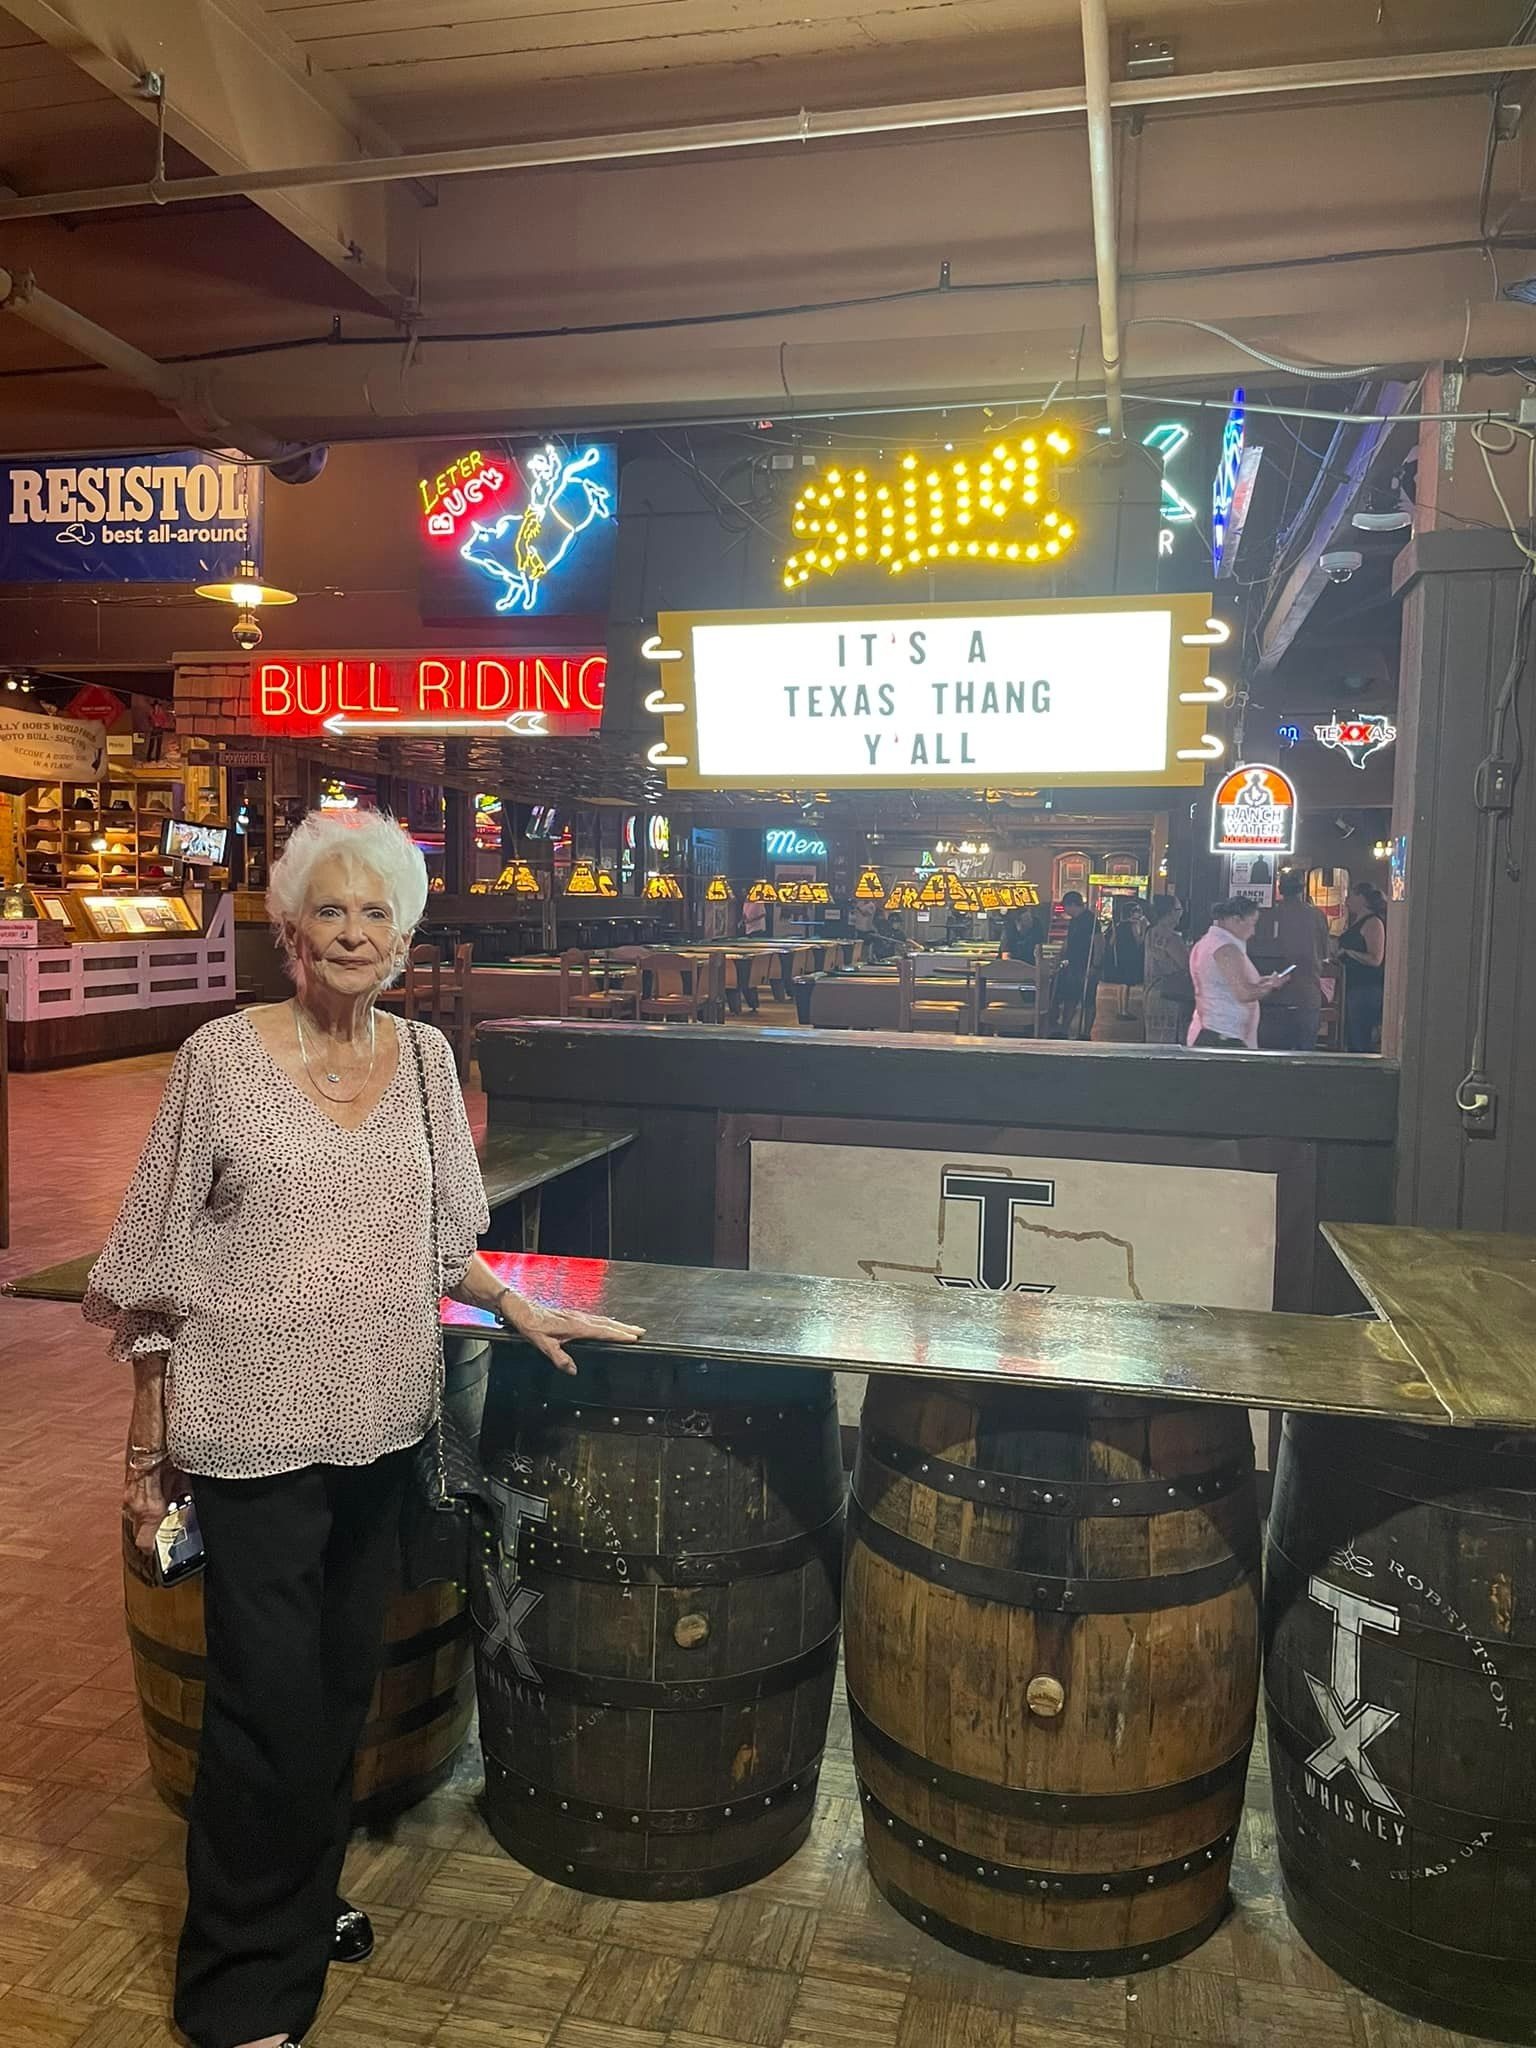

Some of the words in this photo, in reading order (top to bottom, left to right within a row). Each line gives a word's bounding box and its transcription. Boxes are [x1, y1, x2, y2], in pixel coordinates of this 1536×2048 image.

[9, 464, 248, 523] RESISTOL
[419, 450, 484, 515] LET'ER
[428, 467, 503, 535] BUCK
[783, 428, 1075, 589] Shiner
[102, 525, 143, 543] best
[148, 524, 247, 543] all-around
[838, 631, 926, 667] IT'S
[968, 630, 986, 663] A
[262, 661, 399, 715] BULL
[420, 657, 607, 711] RIDING
[784, 683, 895, 717] TEXAS
[932, 680, 1051, 714] THANG
[864, 732, 976, 765] Y'ALL
[1226, 807, 1281, 821] RANCH
[1226, 822, 1281, 835] WATER
[766, 830, 827, 855] Men
[1387, 1558, 1514, 1732] ROBERTSON
[1304, 1772, 1405, 1846] WHISKEY
